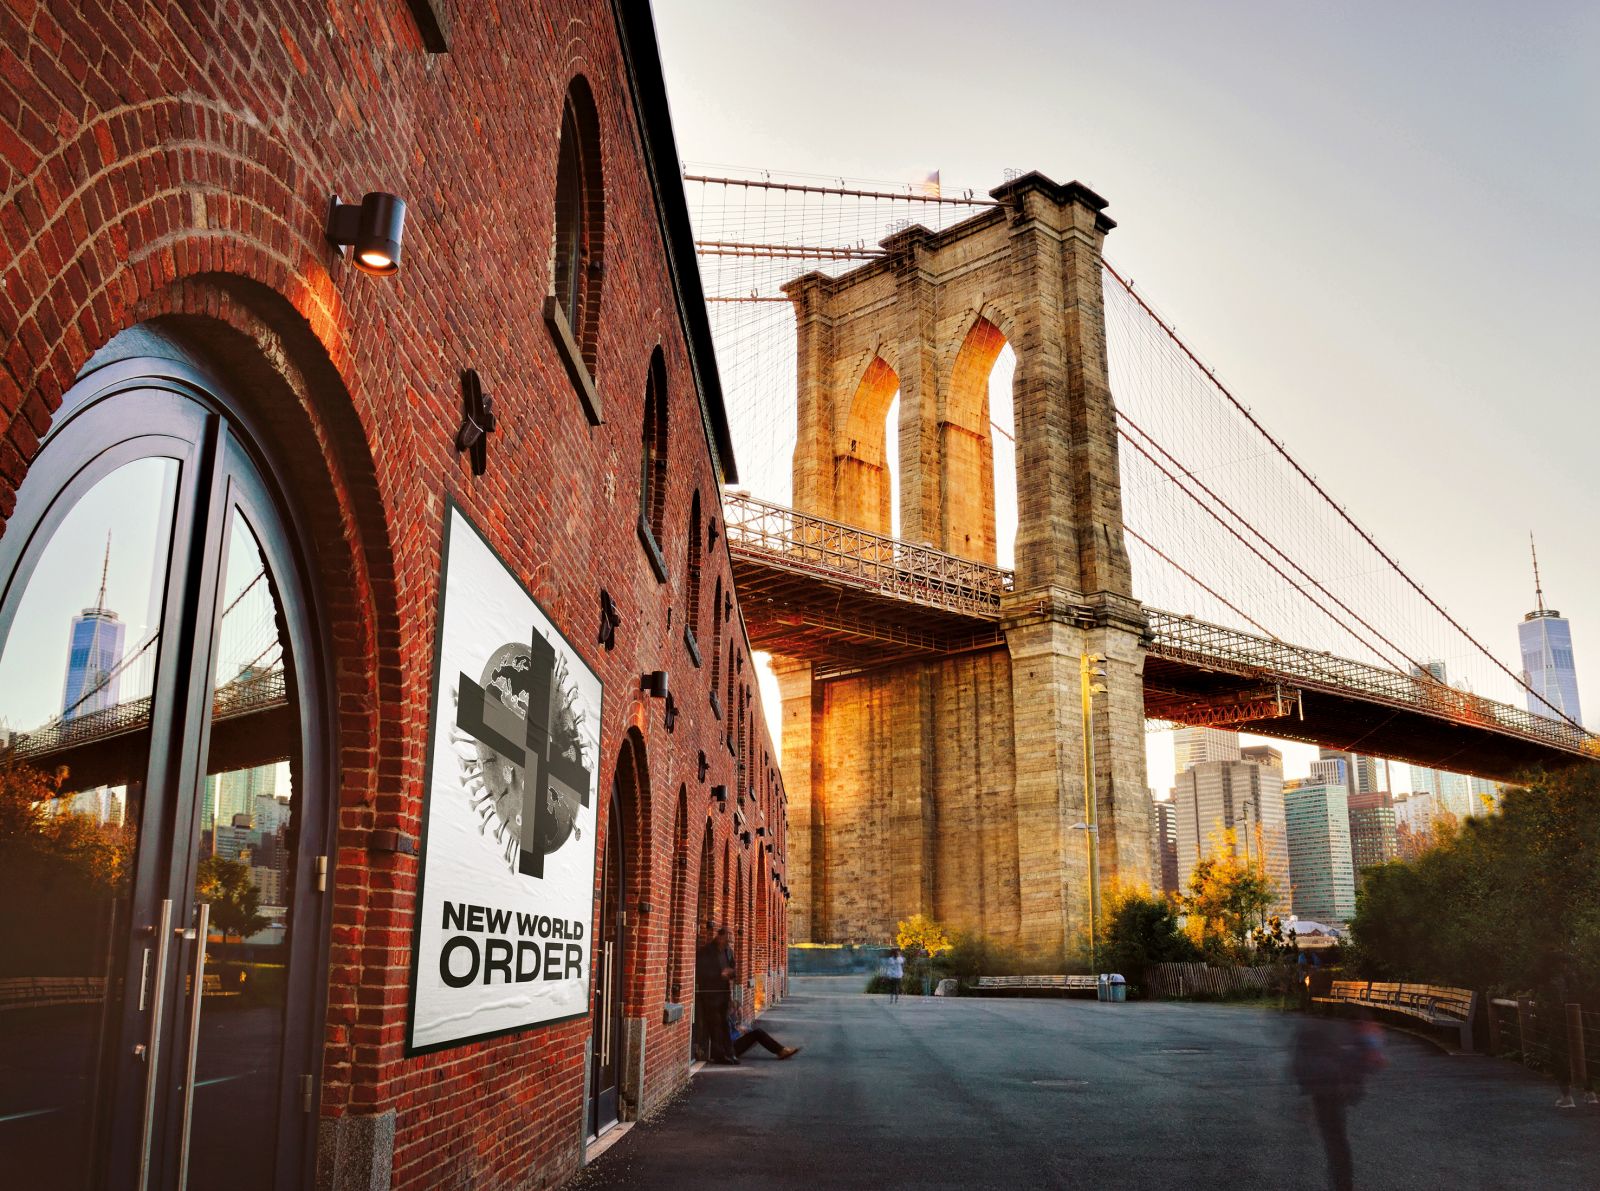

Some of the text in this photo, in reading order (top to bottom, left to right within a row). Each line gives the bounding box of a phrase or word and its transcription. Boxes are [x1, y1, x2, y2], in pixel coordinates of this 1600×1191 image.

[442, 901, 584, 941] NEW WORLD
[439, 935, 583, 988] ORDER
